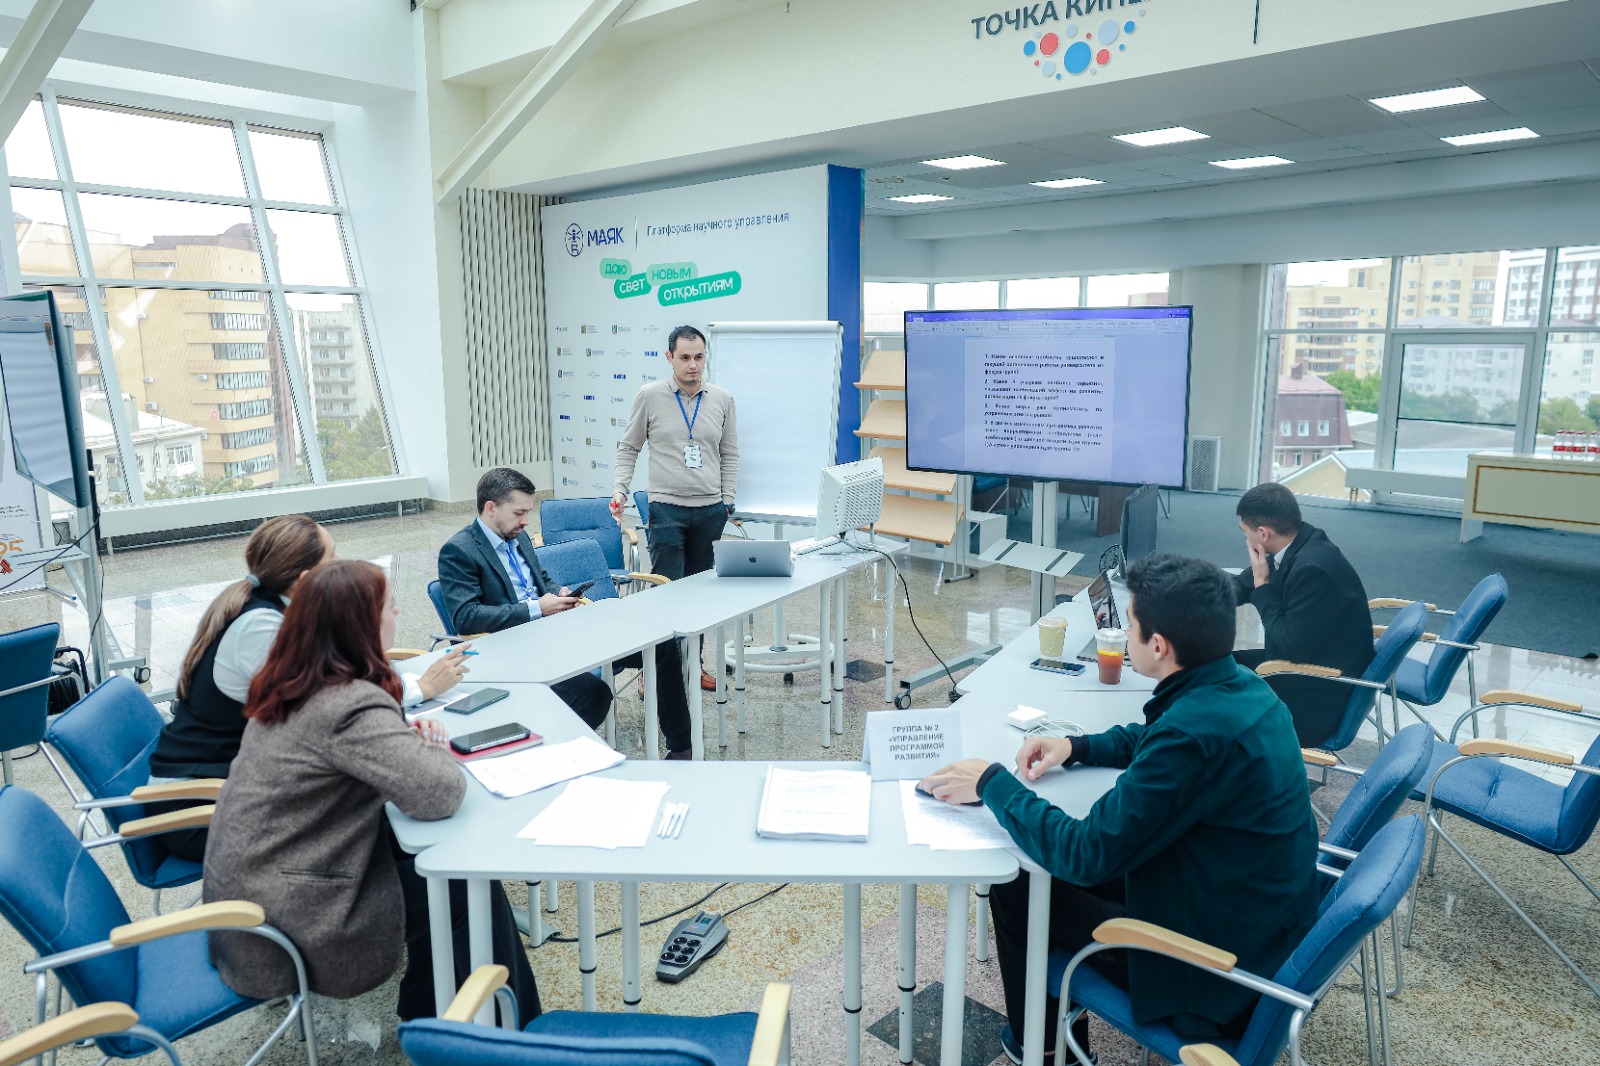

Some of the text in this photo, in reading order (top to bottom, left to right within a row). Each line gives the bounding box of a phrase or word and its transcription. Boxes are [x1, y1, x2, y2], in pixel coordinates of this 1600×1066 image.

[971, 0, 1142, 39] ТОЧКА КИ
[647, 212, 790, 237] Платформа научного управления
[587, 226, 624, 247] МАЯК
[651, 267, 691, 280] новым
[619, 278, 646, 294] свет
[663, 277, 734, 301] открытиям
[892, 725, 923, 734] ГРУППА
[924, 724, 933, 732] №
[888, 733, 944, 743] «УПРАВЛЕНИЕ
[889, 741, 945, 752] ПРОГРАММОЙ
[894, 751, 941, 761] РАЗВИТИЯ»
